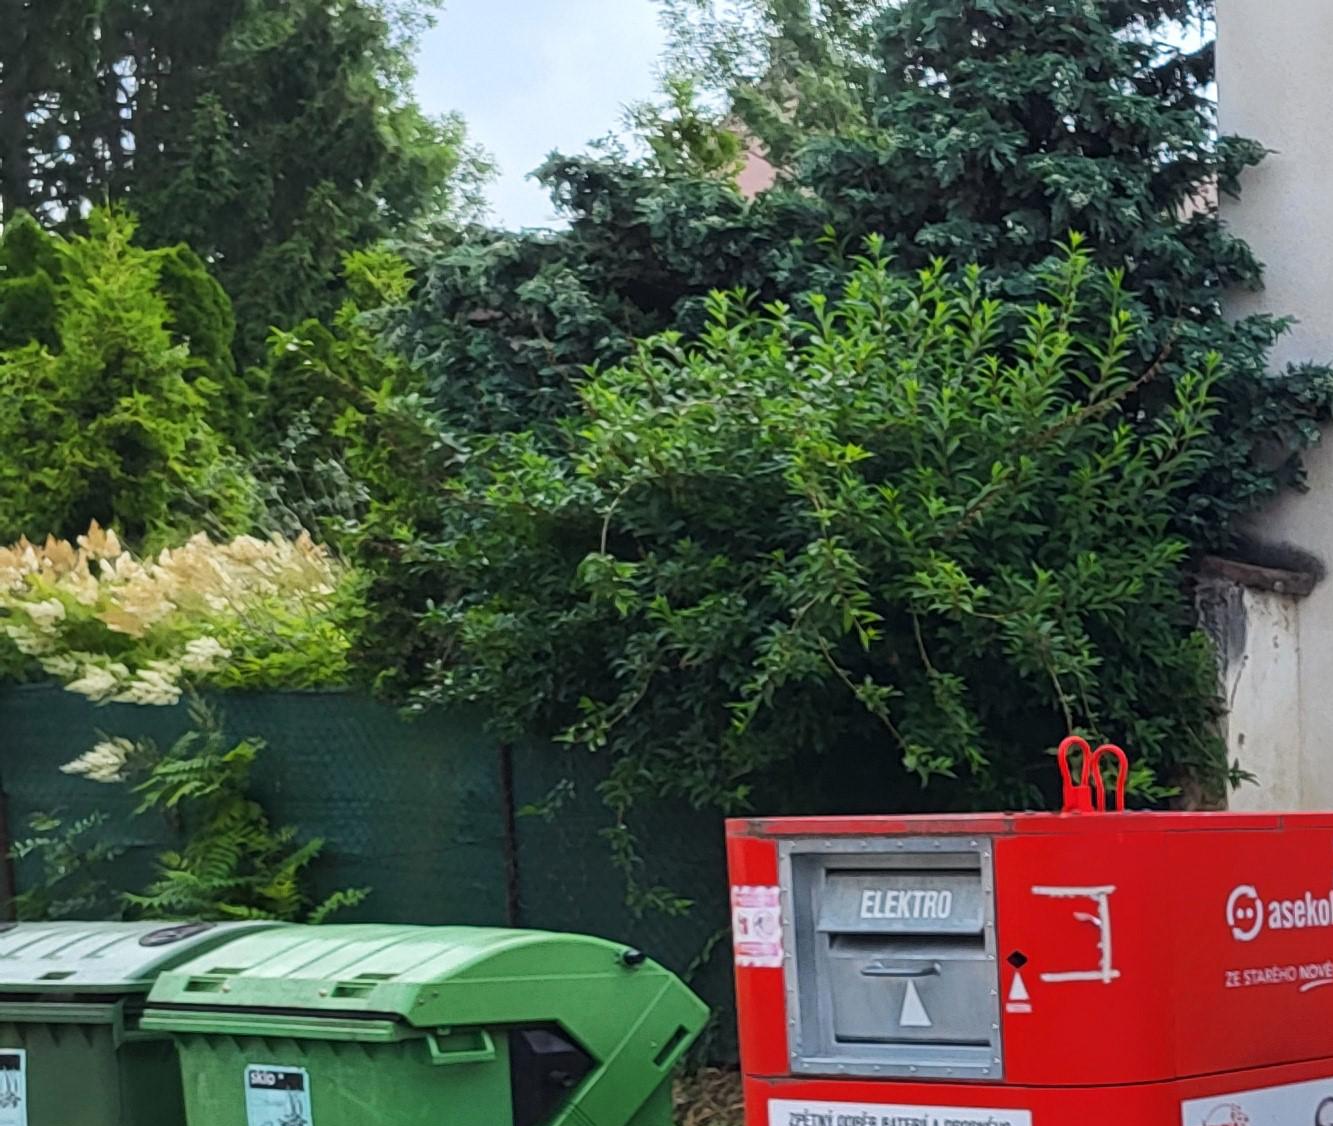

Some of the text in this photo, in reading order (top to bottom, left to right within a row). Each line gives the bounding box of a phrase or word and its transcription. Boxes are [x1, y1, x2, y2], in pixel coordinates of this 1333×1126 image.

[861, 889, 952, 919] ELEKTRO
[1225, 970, 1240, 987] ZE
[1243, 964, 1297, 985] STARÉHO
